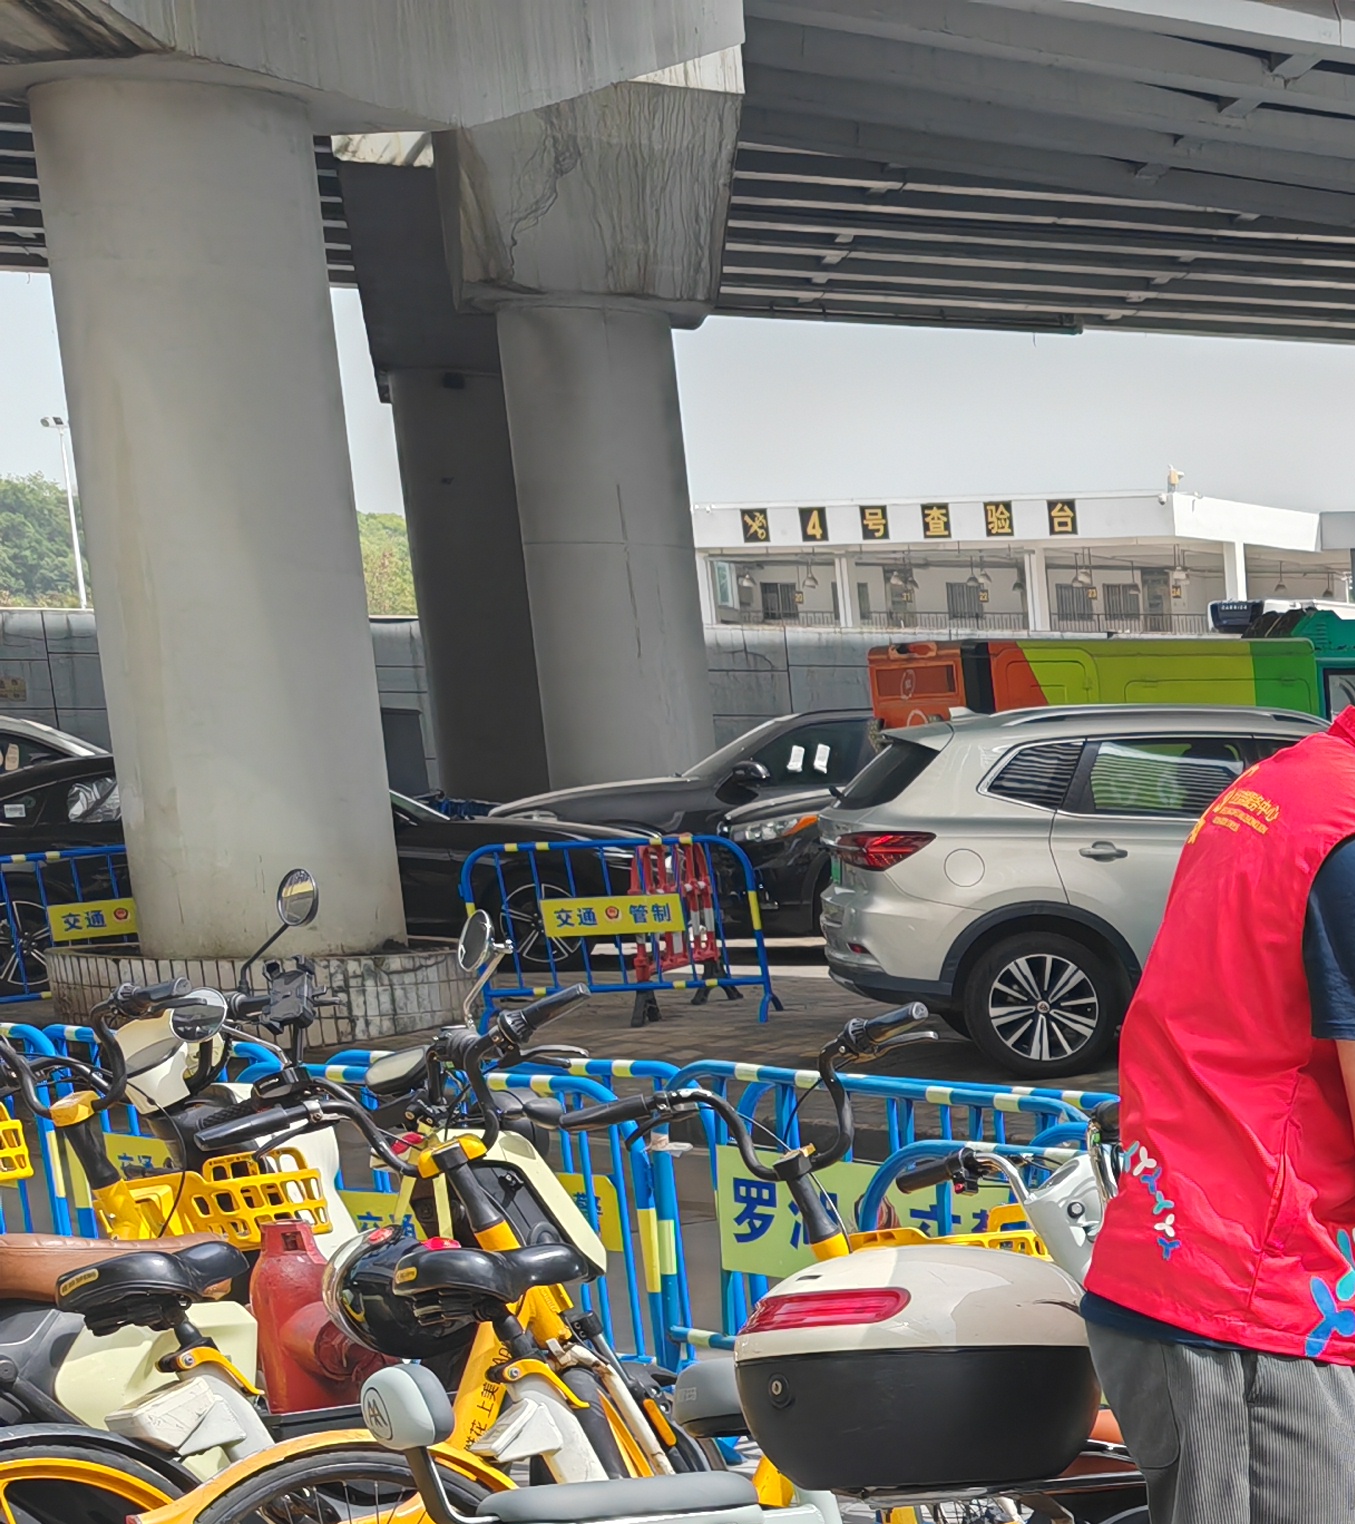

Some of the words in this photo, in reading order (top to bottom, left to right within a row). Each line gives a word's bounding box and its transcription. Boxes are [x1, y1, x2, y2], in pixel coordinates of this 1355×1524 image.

[806, 503, 1075, 540] 4号查验台
[553, 907, 598, 928] 交通
[628, 902, 672, 924] 管制
